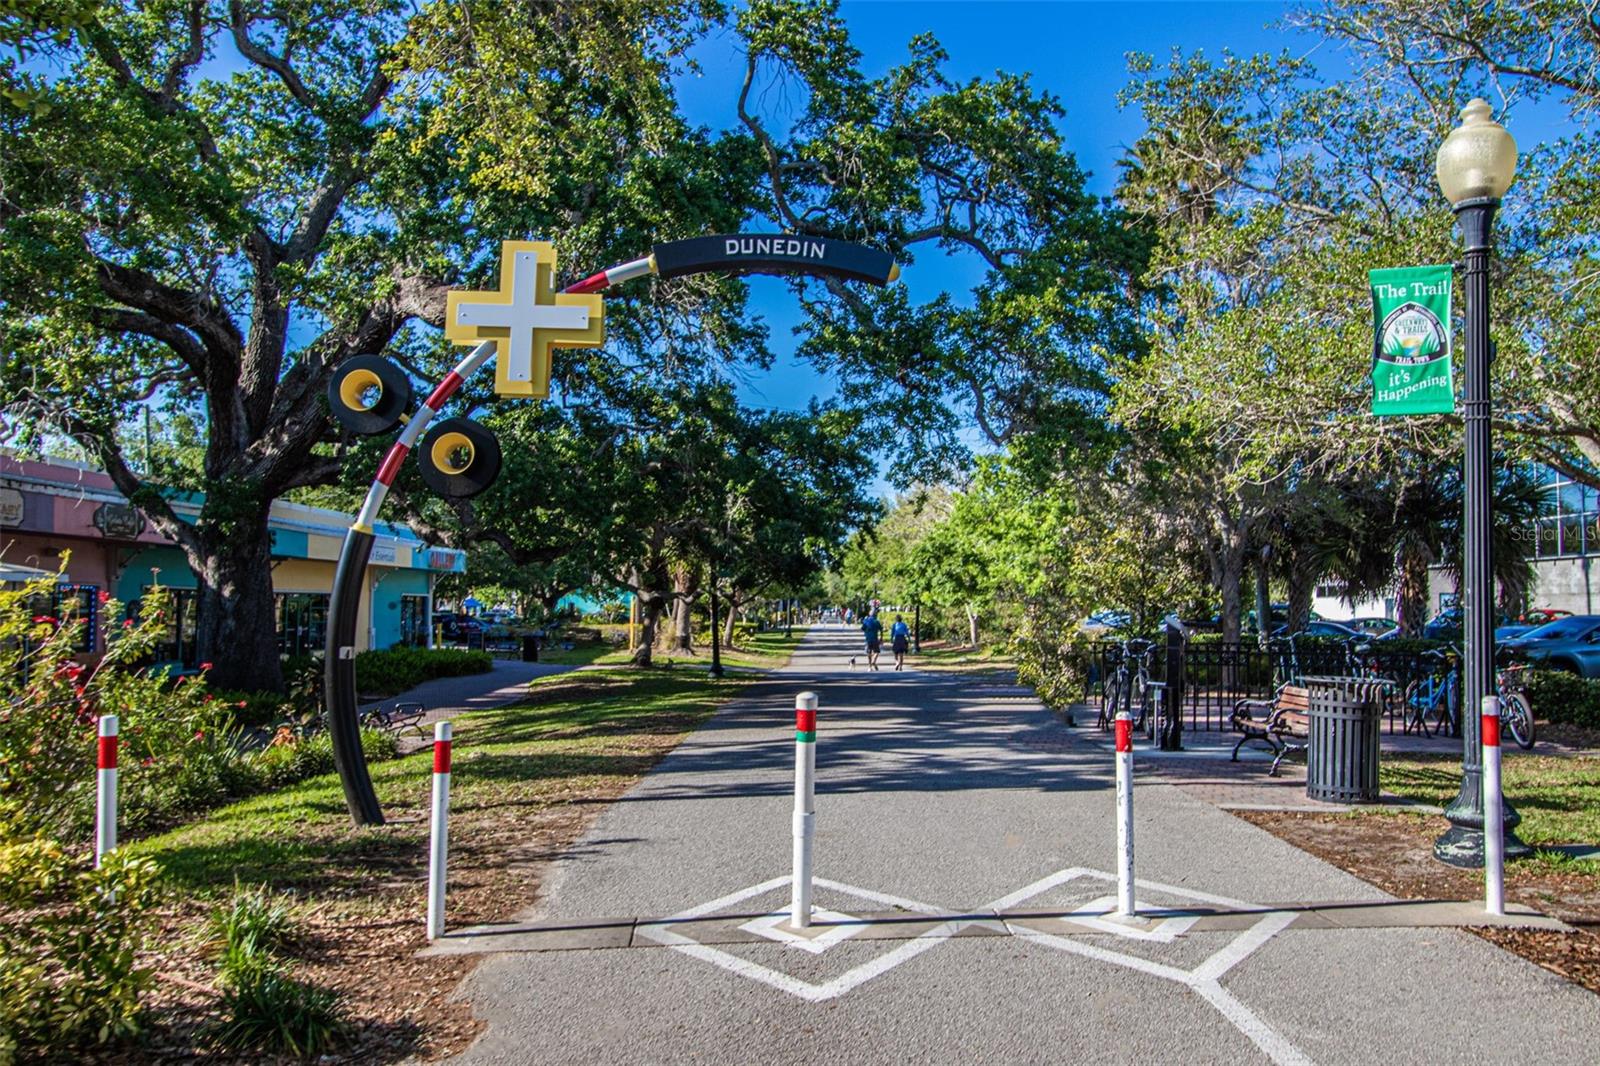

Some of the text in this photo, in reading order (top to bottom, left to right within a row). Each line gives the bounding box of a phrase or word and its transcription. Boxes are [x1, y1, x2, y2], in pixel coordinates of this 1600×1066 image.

[725, 239, 825, 259] DUNEDIN
[1374, 280, 1448, 298] The Trail
[1403, 326, 1429, 334] TRAILS
[1395, 356, 1412, 364] TRAIL
[1378, 375, 1447, 402] Happening
